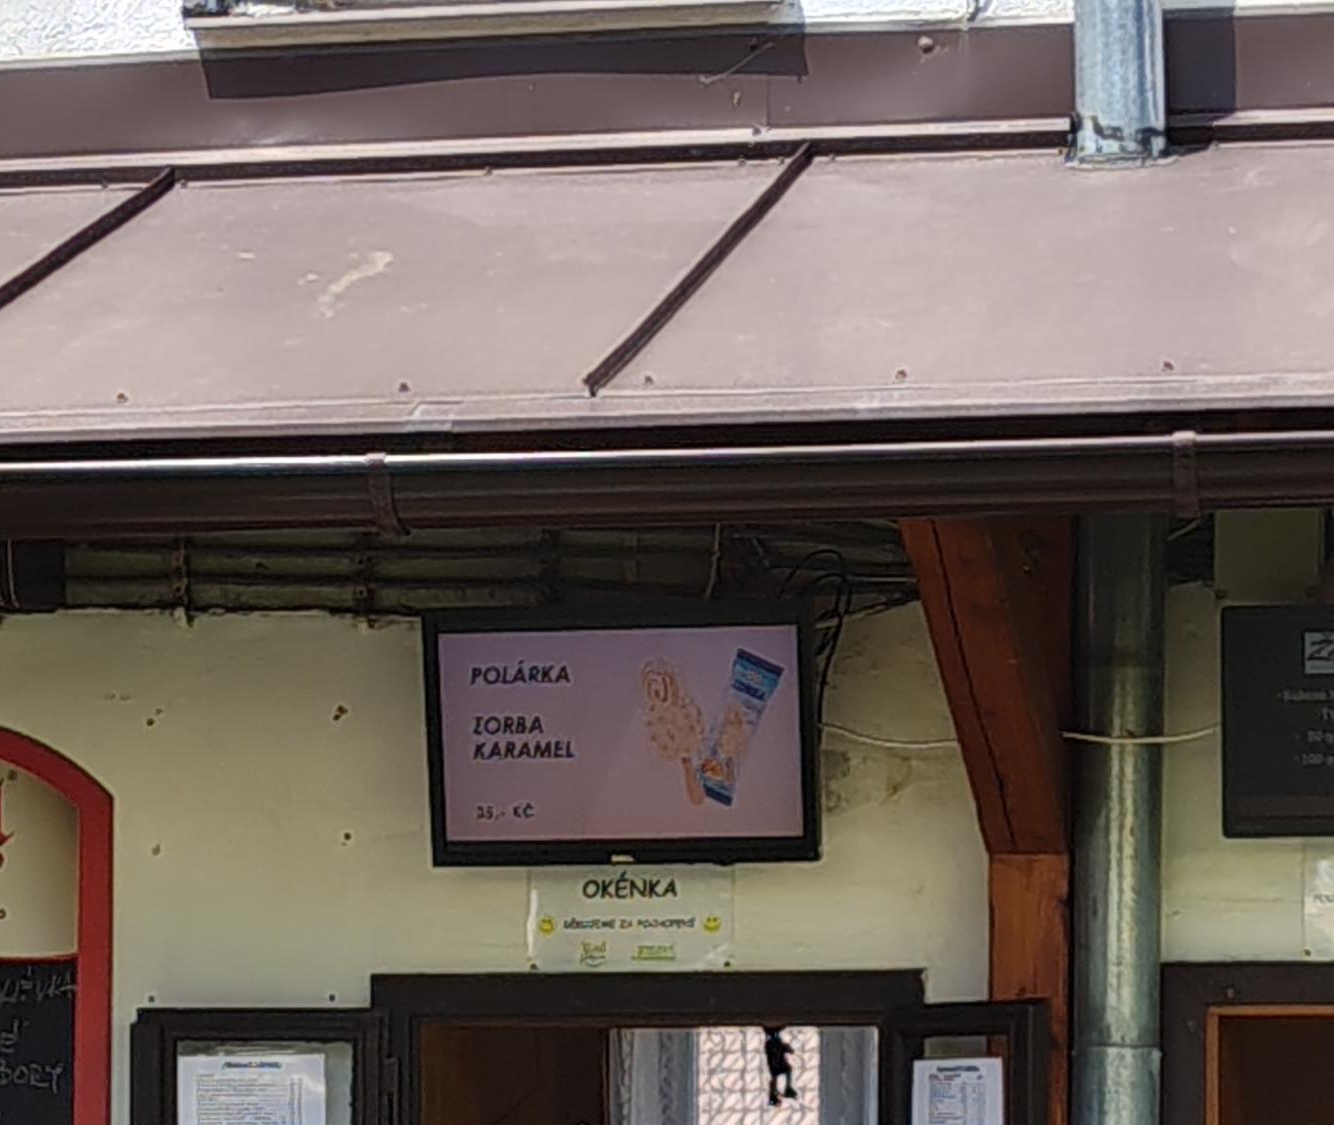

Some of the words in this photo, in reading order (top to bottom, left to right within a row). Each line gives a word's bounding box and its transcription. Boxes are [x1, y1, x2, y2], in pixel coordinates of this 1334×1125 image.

[470, 659, 571, 686] POLÁRKA
[473, 716, 544, 736] ZORBA
[473, 740, 575, 760] KARAMEL
[513, 802, 535, 819] KČ
[582, 872, 678, 899] OKÉNKA
